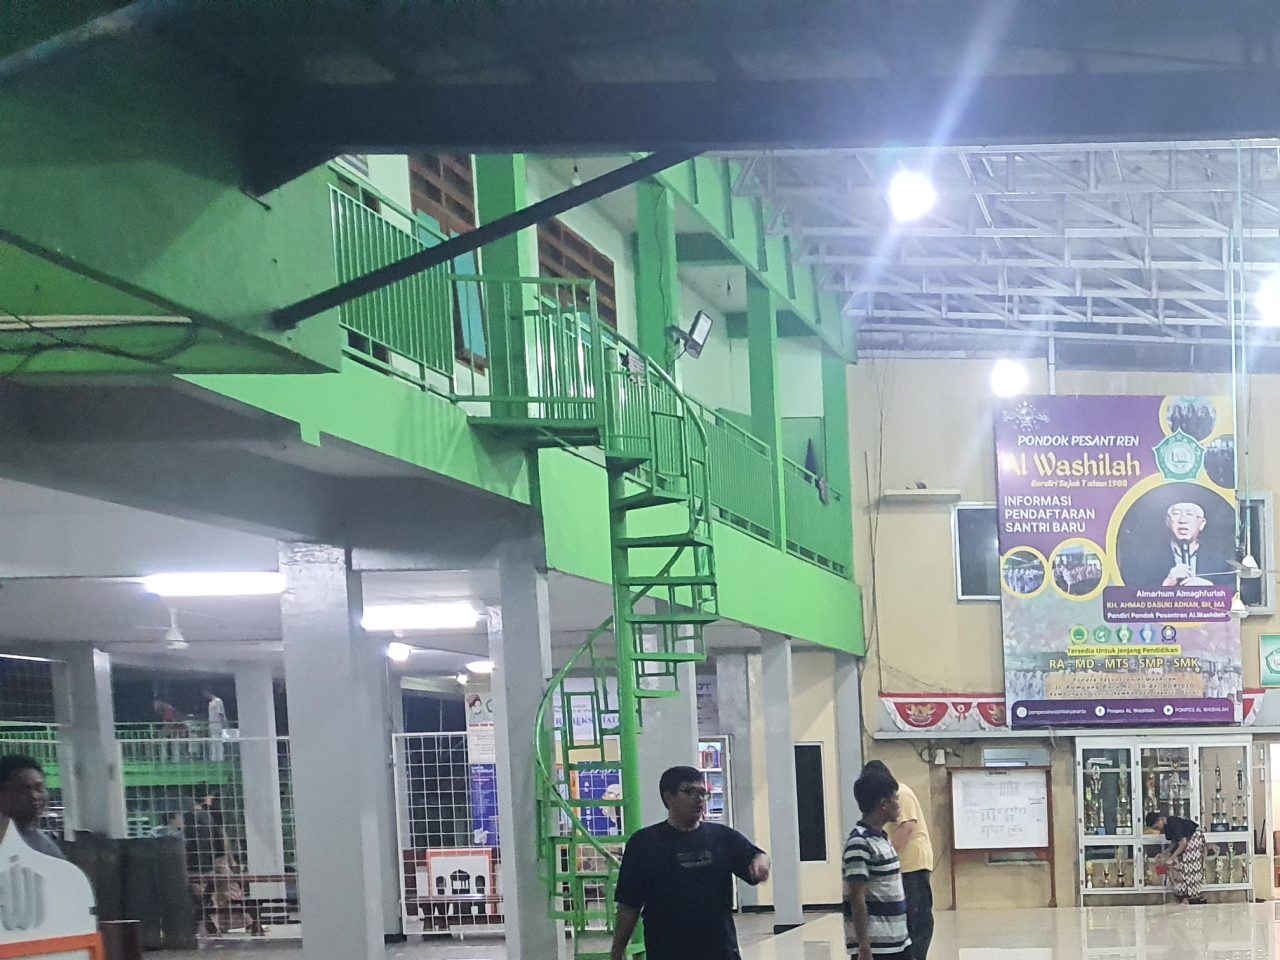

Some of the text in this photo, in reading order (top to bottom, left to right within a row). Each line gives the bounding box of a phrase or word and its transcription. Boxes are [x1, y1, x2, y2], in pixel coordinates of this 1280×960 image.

[1018, 435, 1140, 447] PONDOK PESANTREN
[1033, 451, 1141, 476] Washilah
[1059, 480, 1080, 489] Sejak
[1004, 495, 1072, 507] INFORMASI
[1005, 508, 1095, 520] PENDAFTARAN
[1005, 521, 1086, 533] SANTRI BARU
[1136, 590, 1174, 598] Almarhum
[1155, 611, 1188, 619] Pesantren
[1117, 646, 1141, 655] Jenjang
[1142, 645, 1179, 654] Pendidikan
[1049, 657, 1200, 669] RA MD MTS SMP SMK
